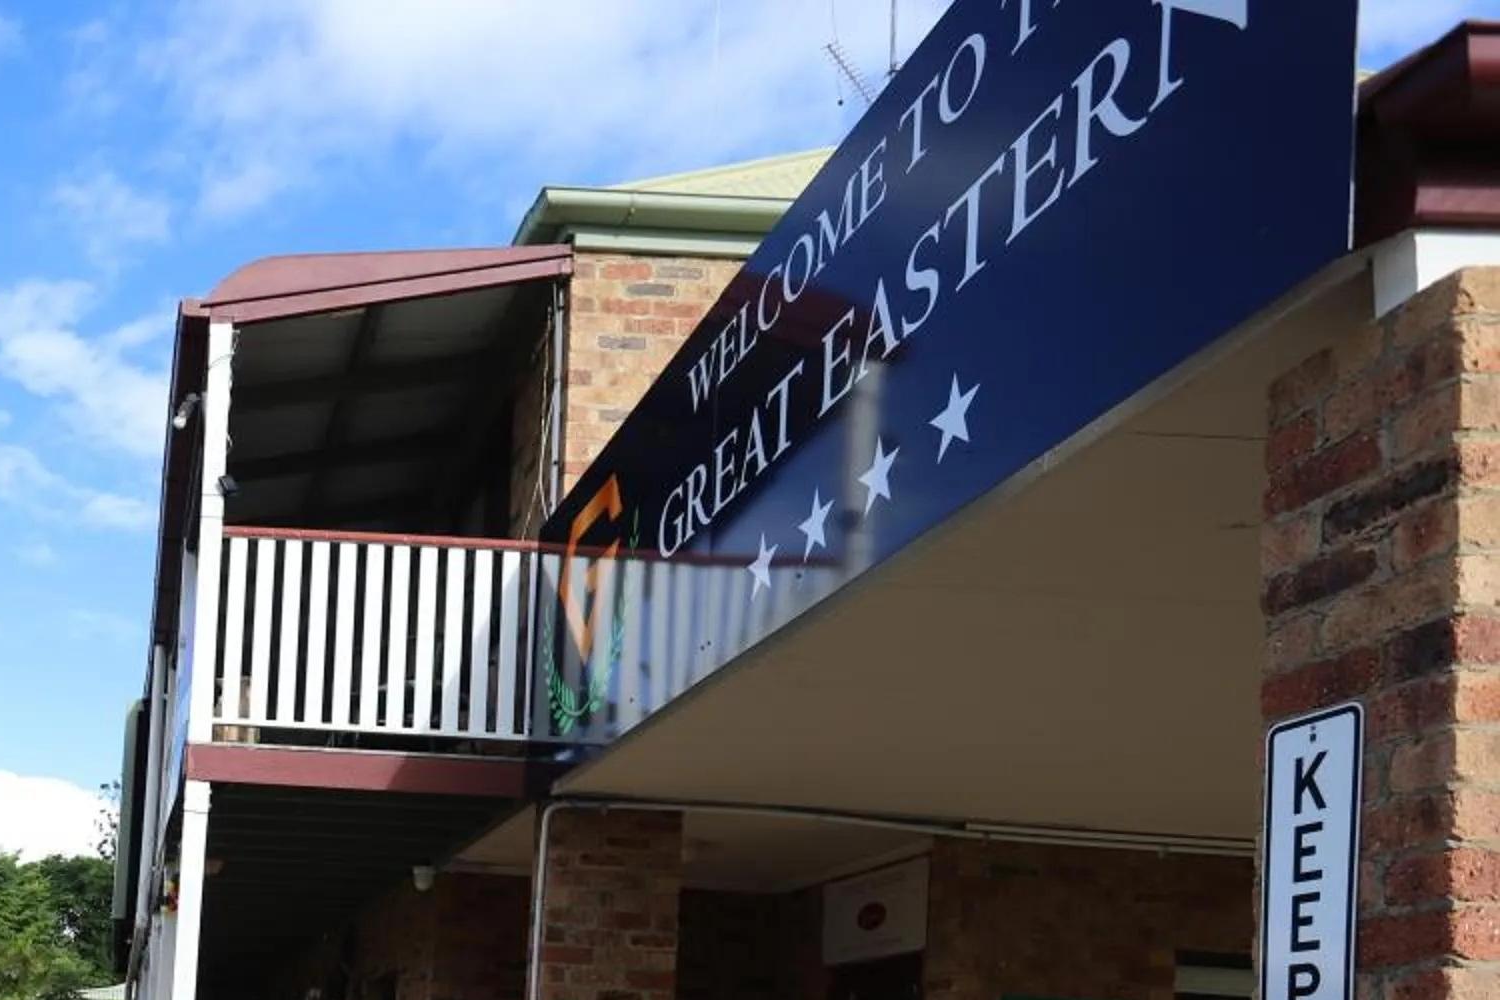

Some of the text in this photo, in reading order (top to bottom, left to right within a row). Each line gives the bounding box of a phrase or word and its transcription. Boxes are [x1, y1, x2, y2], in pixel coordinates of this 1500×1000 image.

[687, 32, 987, 414] WELCOME TO
[657, 361, 805, 560] GREAT
